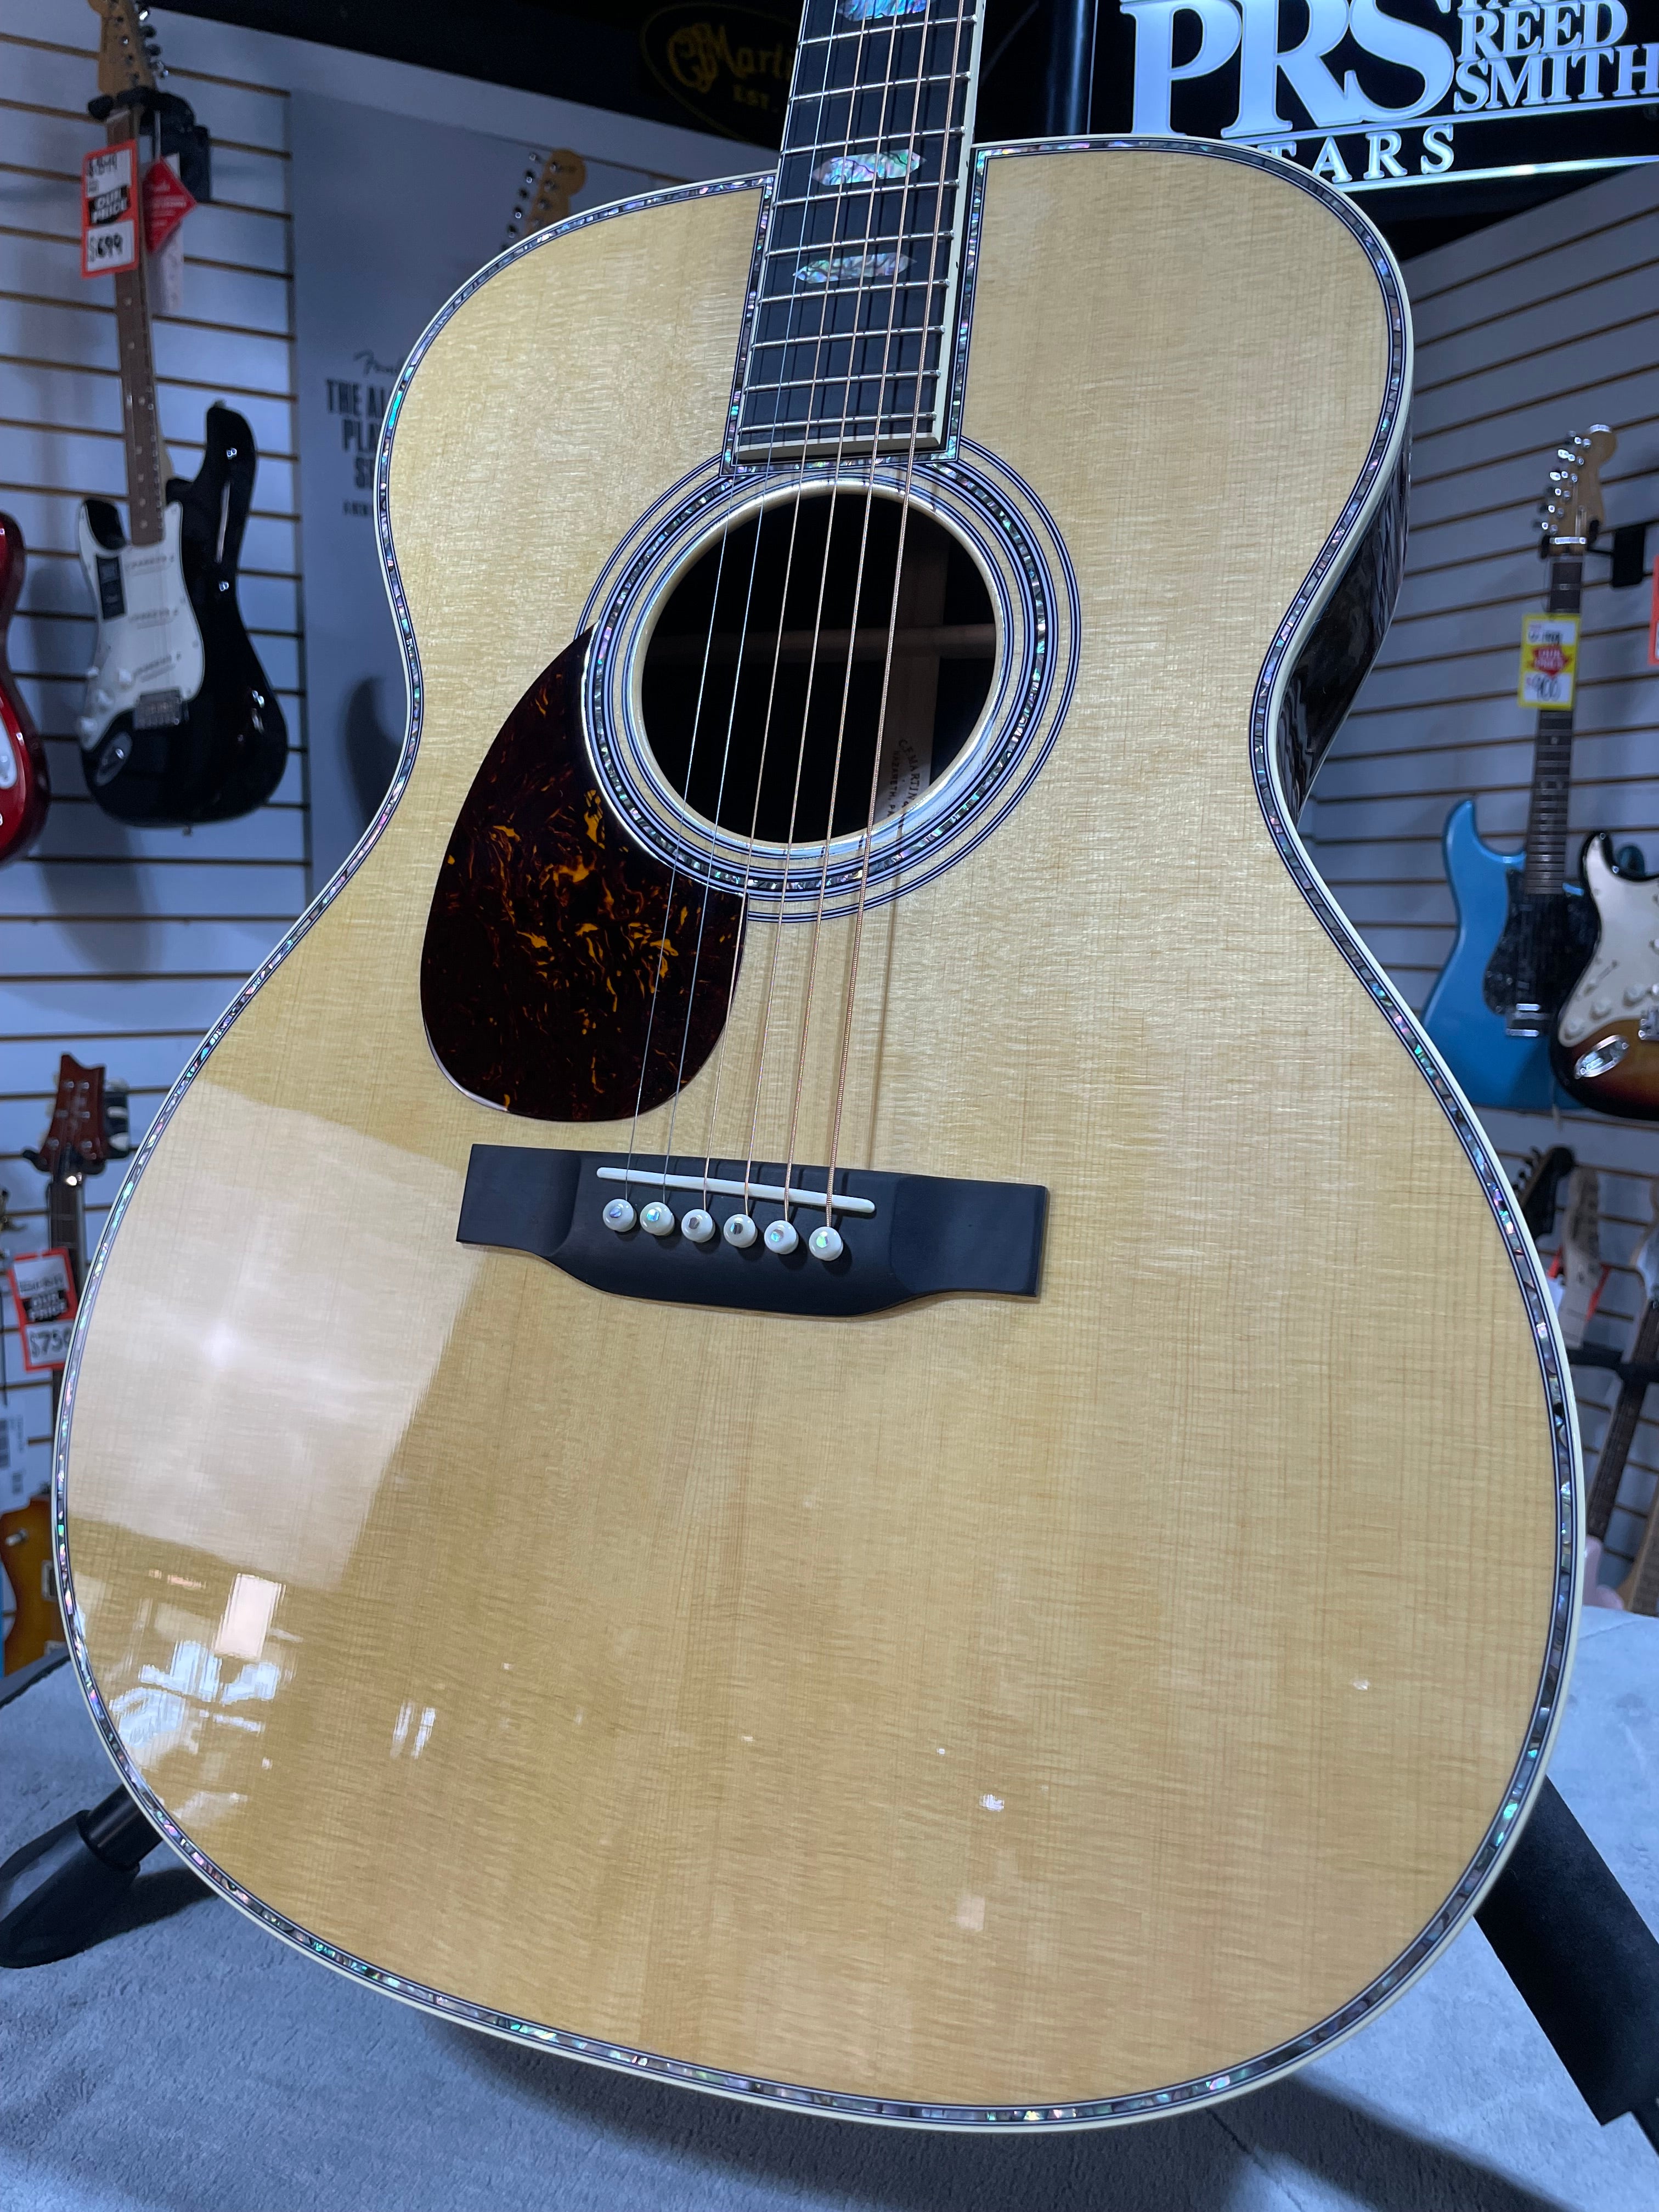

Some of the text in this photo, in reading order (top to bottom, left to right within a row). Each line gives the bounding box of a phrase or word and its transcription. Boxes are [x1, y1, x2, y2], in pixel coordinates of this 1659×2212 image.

[1456, 0, 1628, 62] REED
[1120, 0, 1454, 136] PRS
[1453, 43, 1659, 112] SMITH
[327, 379, 362, 416] THE
